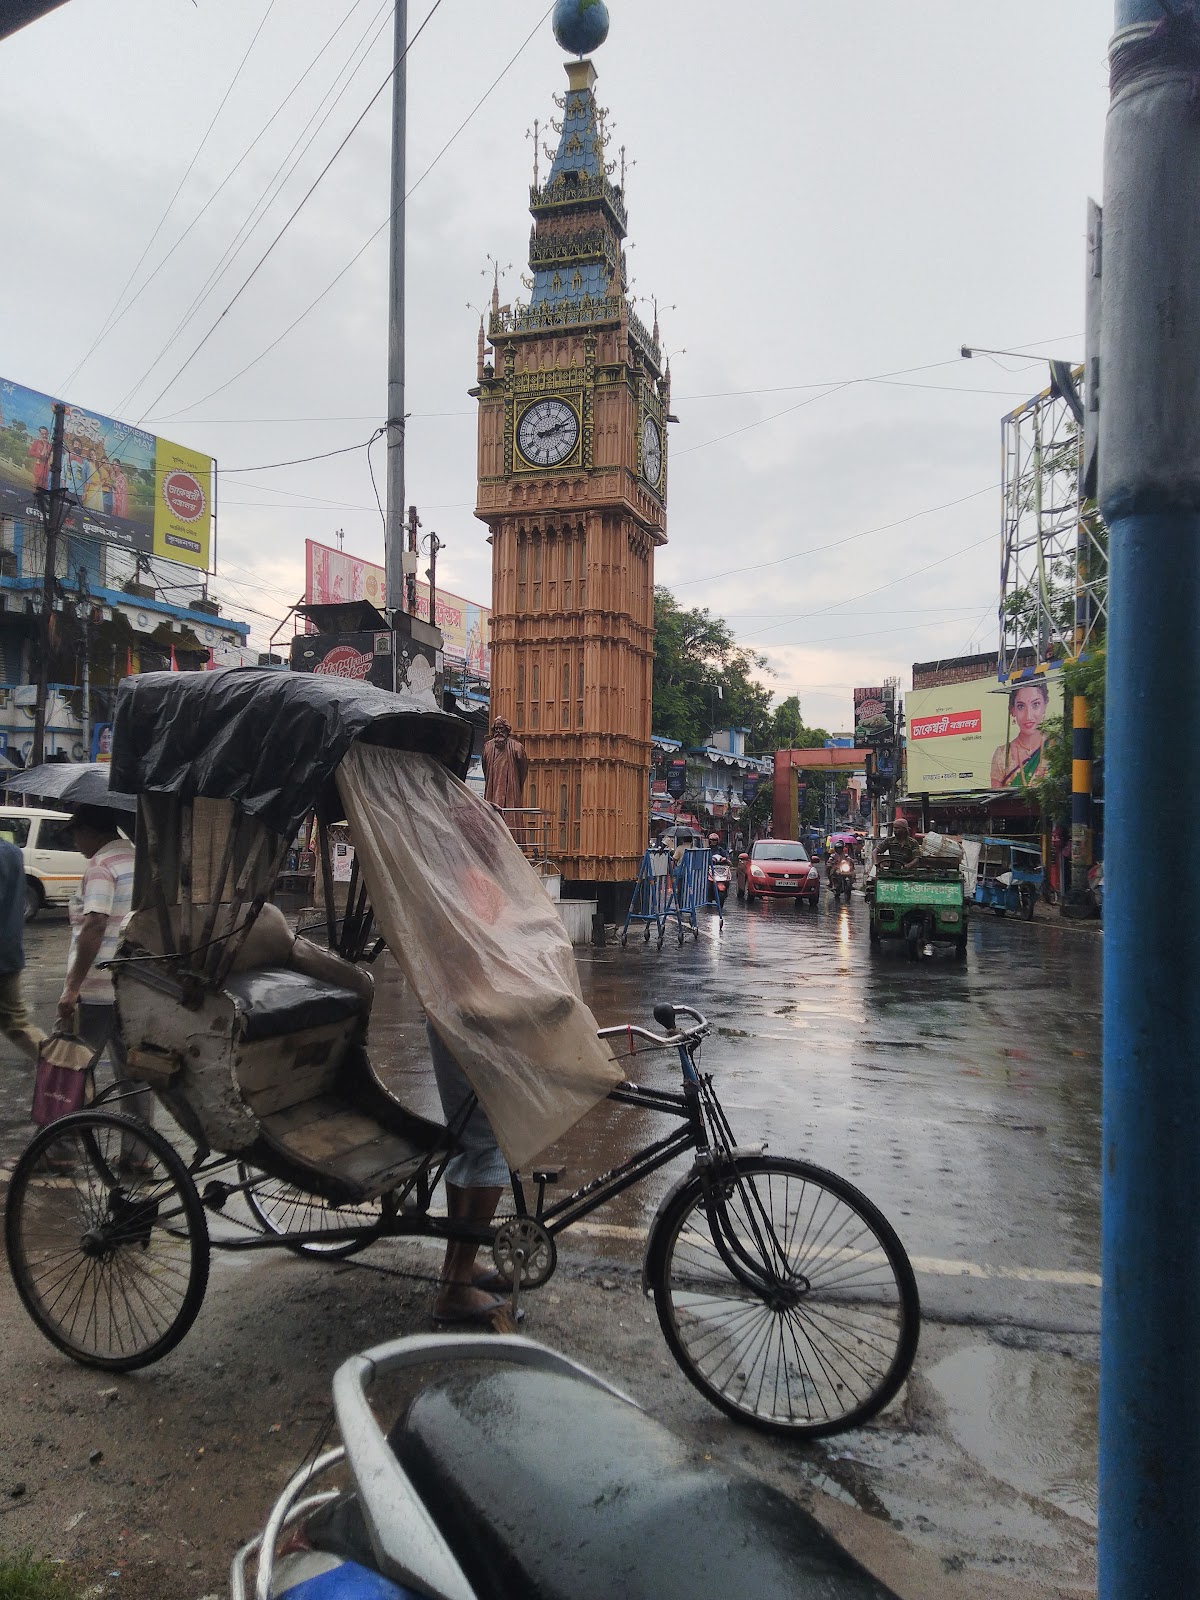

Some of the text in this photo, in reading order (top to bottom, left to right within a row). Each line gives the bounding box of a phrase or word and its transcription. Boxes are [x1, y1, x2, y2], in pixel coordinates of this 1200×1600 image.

[113, 421, 154, 442] IN CINEMAS
[133, 436, 153, 451] MAY
[313, 651, 374, 676] Crispy FRIED
[912, 717, 950, 737] ঢাকেশ্বরী
